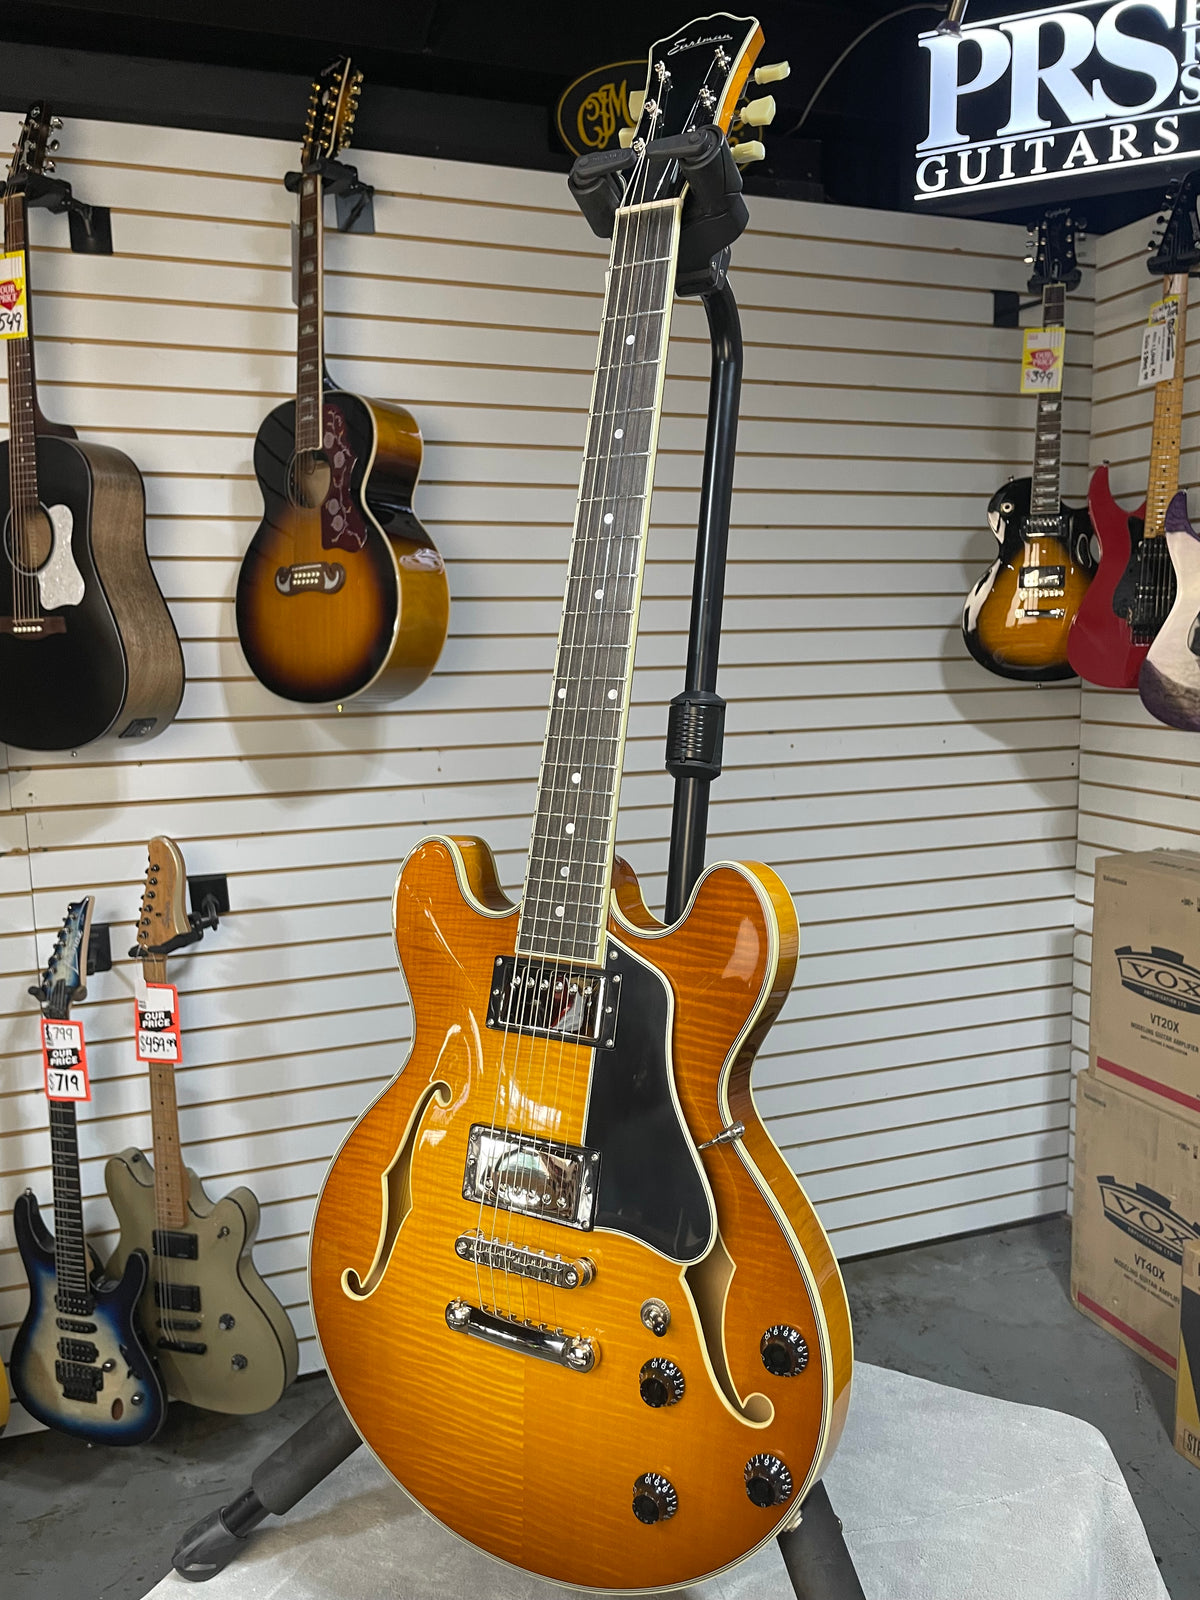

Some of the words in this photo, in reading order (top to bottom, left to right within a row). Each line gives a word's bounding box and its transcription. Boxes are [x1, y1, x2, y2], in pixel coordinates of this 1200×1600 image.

[916, 0, 1179, 151] PRS
[915, 115, 1180, 193] GUITARS
[1127, 961, 1200, 998] VOX
[142, 1018, 171, 1029] PRICE
[1150, 1012, 1180, 1034] VT20X
[50, 1055, 78, 1066] PRICE
[52, 1050, 73, 1058] OUR
[48, 1073, 80, 1092] $719
[1110, 1191, 1194, 1246] VOX
[1134, 1252, 1166, 1282] VT40X
